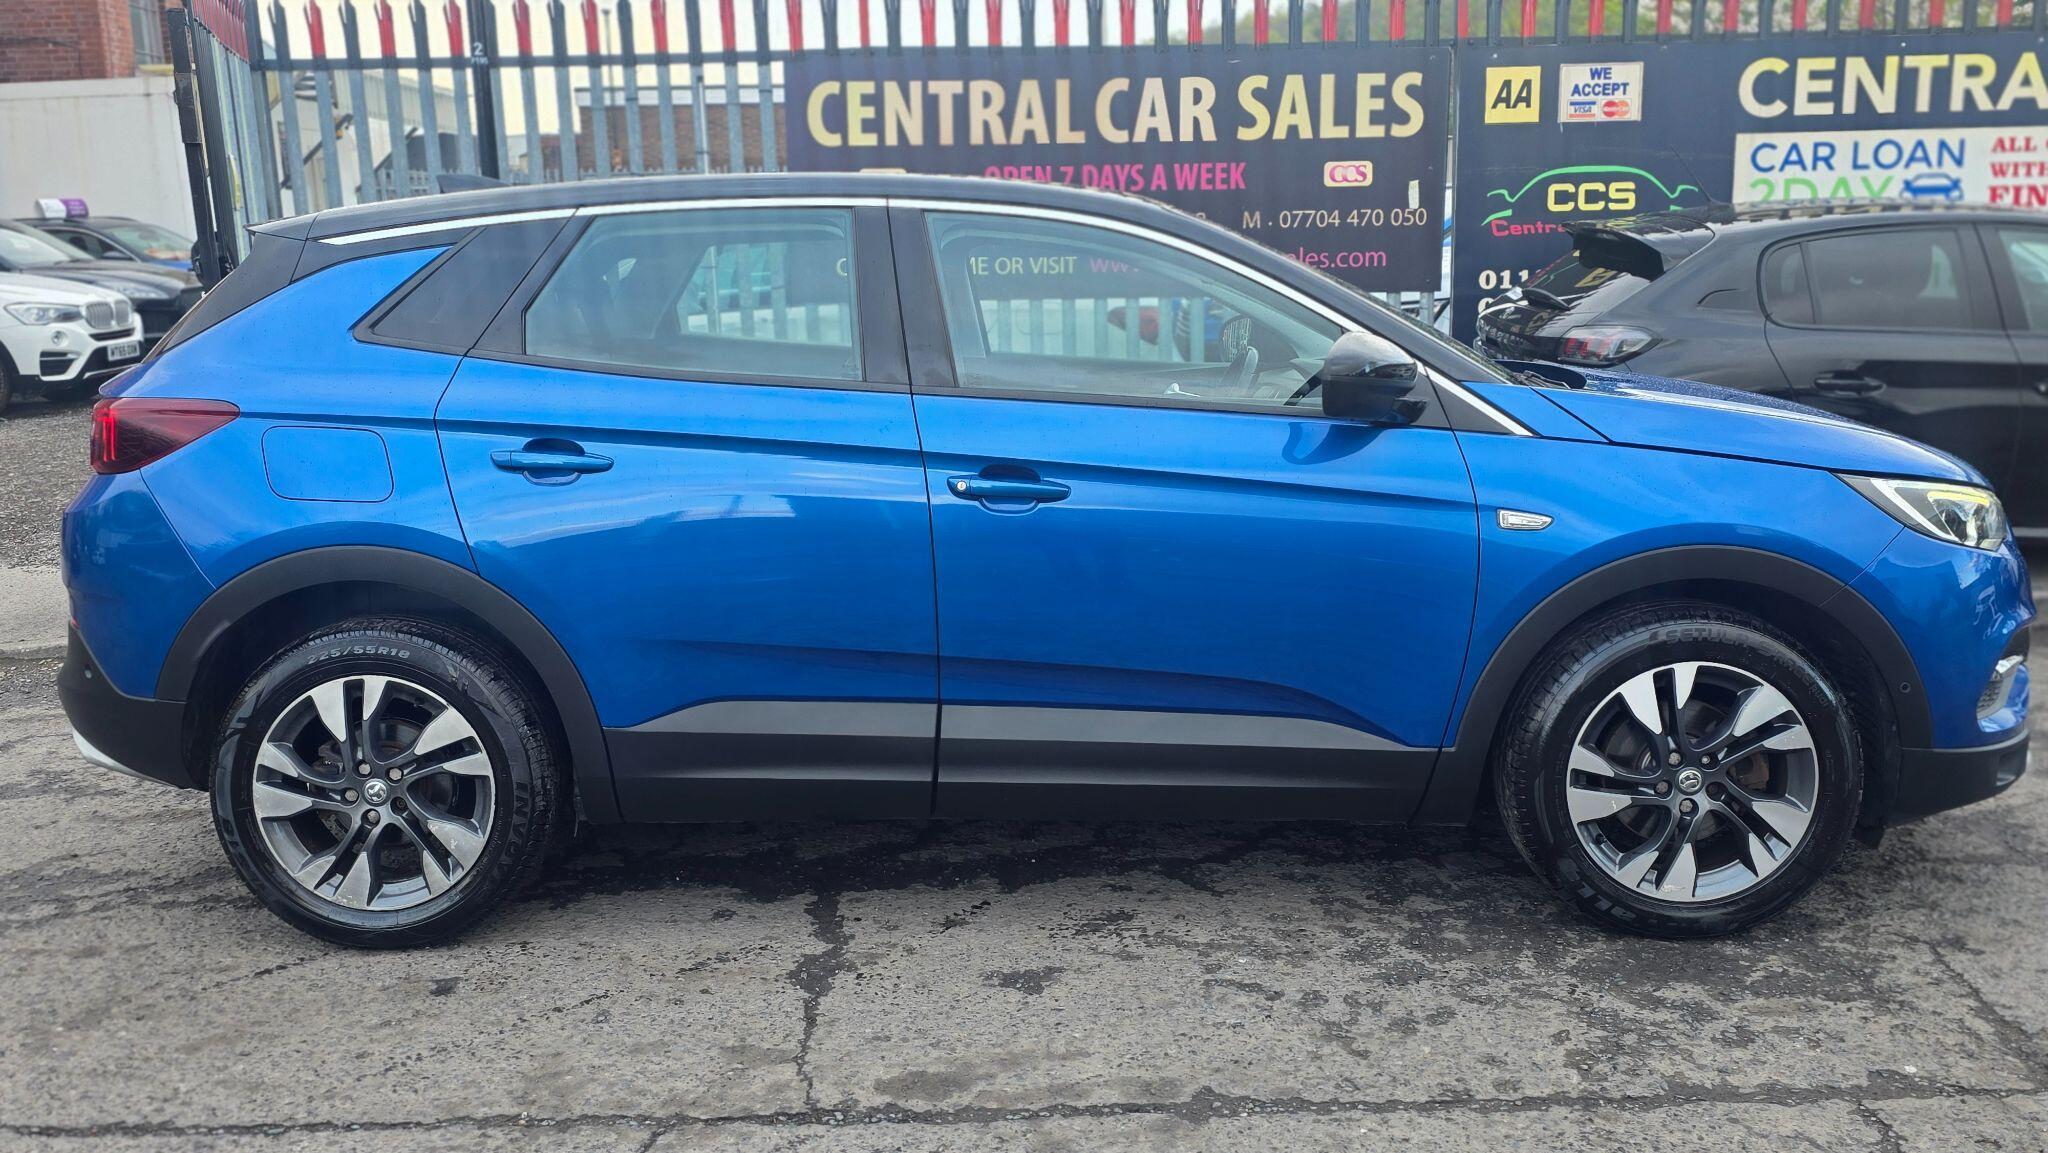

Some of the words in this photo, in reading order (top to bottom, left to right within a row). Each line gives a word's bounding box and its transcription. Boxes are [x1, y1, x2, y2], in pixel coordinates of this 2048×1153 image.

[473, 42, 483, 55] 2
[1590, 67, 1612, 80] WE
[1491, 79, 1532, 109] AA
[1571, 82, 1629, 97] ACCEPT
[1738, 52, 2048, 117] CENTRA
[807, 79, 1086, 147] CENTRAL
[1095, 76, 1217, 144] CAR
[1236, 72, 1424, 141] SALES
[1750, 142, 1836, 172] CAR
[1852, 138, 1966, 169] LOAN
[1990, 136, 2036, 153] ALL
[1060, 166, 1074, 186] 7
[1082, 163, 1145, 192] DAYS
[1151, 163, 1168, 191] A
[1173, 162, 1246, 190] WEEK
[1329, 164, 1367, 182] CCS
[1547, 181, 1636, 211] CCS
[1750, 176, 1894, 202] 2DAY
[1242, 211, 1261, 229] M
[1279, 210, 1341, 229] 07704
[1346, 209, 1384, 227] 470
[1390, 208, 1427, 226] 050
[994, 256, 1024, 275] OR
[1029, 256, 1077, 275] VISIT
[307, 645, 411, 665] 225/55R18
